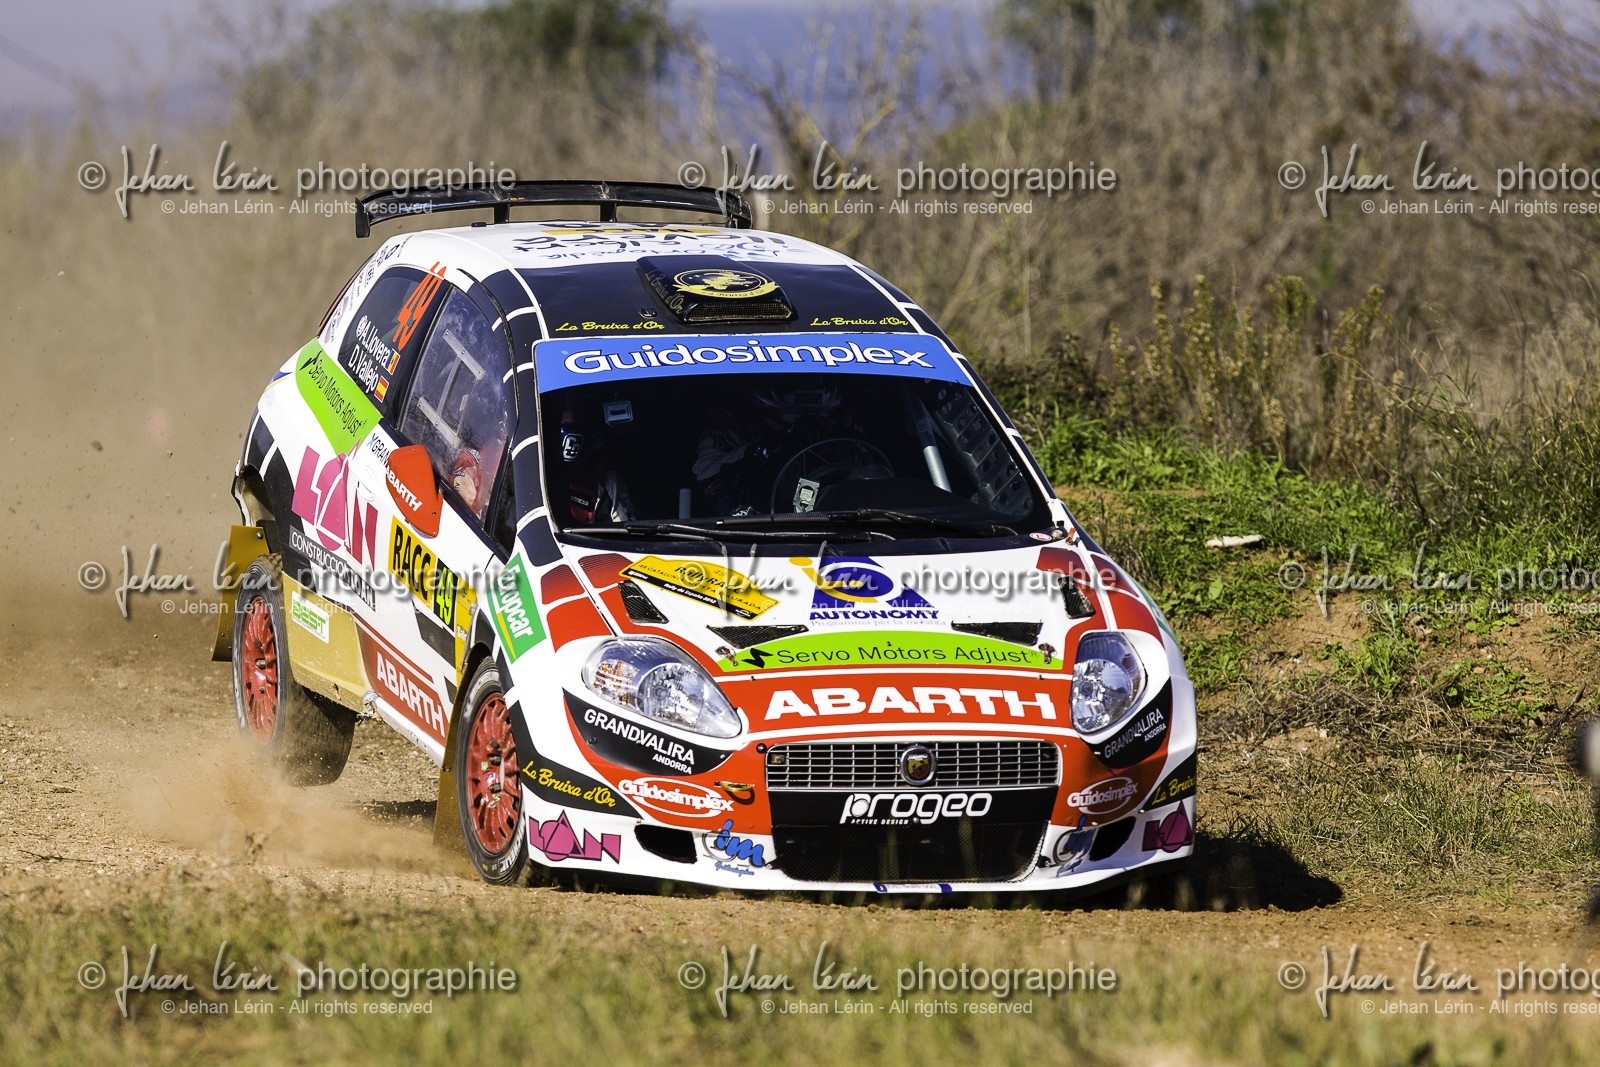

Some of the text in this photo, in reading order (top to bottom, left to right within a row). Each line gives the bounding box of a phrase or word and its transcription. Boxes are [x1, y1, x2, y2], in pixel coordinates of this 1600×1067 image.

[393, 261, 447, 350] 49
[810, 315, 909, 327] La Bruixa d'Or
[556, 320, 664, 333] La Bruixa d'Or
[564, 340, 936, 375] Guidosimplex
[309, 358, 326, 389] Servo
[323, 376, 341, 414] Motors
[386, 464, 423, 512] ABARTH
[392, 524, 453, 626] RACC 49
[497, 564, 534, 639] Europcar
[809, 609, 939, 620] AUTONOMY
[777, 647, 1031, 664] Servo Motors Adjust
[377, 651, 445, 737] ABARTH
[764, 686, 1057, 720] ABARTH
[584, 708, 695, 765] GRANDVALIRA
[1104, 708, 1164, 758] GRANDVALIRA
[1143, 722, 1167, 743] ANDORRA
[522, 760, 537, 779] La
[538, 766, 582, 798] Bruixa
[652, 752, 692, 775] ANDORRA
[618, 778, 734, 812] Guidosimplex
[839, 793, 993, 825] progeo
[1067, 782, 1138, 807] Guidosimplex
[1151, 786, 1166, 806] La
